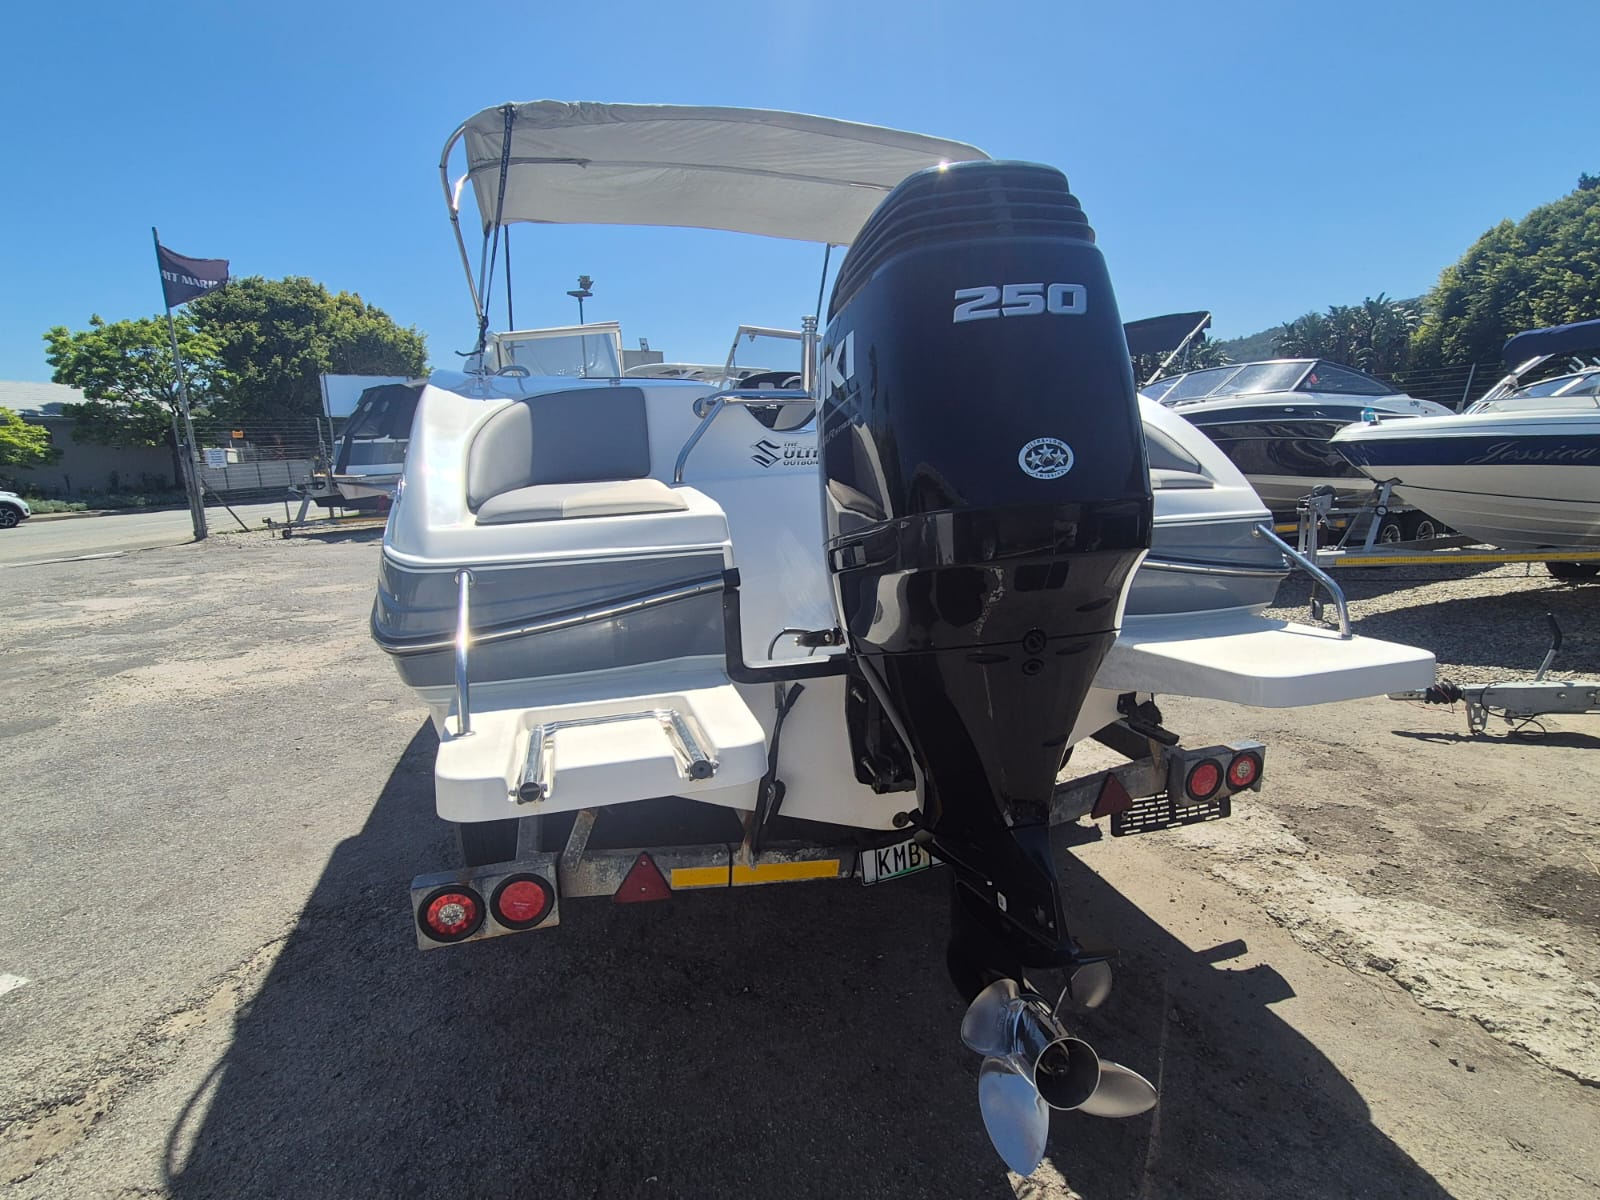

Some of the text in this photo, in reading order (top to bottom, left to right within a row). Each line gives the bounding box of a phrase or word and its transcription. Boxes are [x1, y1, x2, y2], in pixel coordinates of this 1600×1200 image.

[953, 283, 1088, 323] 250
[816, 330, 854, 413] UKI
[783, 447, 818, 459] ULTI
[1464, 440, 1600, 465] Jessica
[878, 842, 921, 876] KMB
